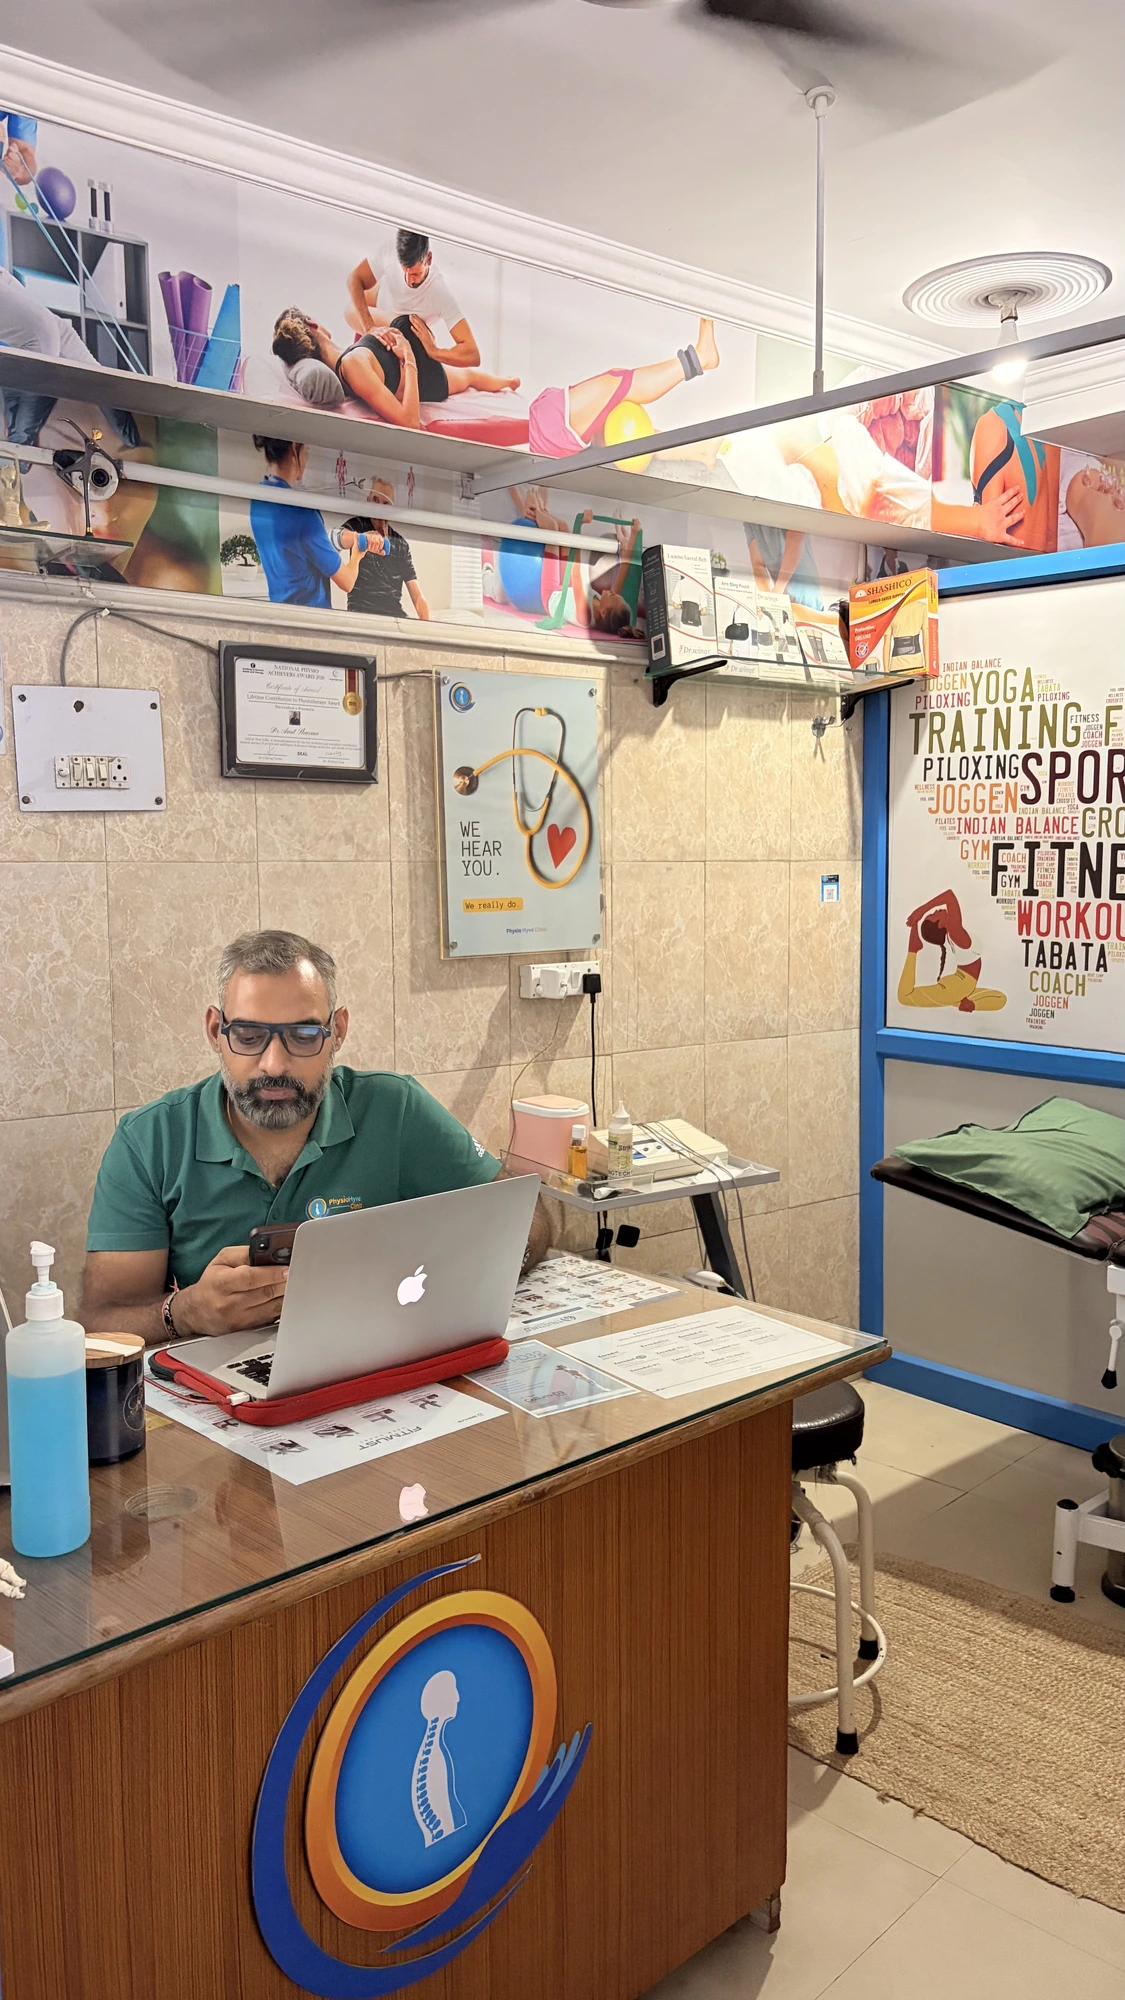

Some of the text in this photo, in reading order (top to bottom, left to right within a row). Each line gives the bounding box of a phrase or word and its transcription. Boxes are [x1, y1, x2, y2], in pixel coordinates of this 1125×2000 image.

[866, 578, 912, 596] SHASHICO
[943, 658, 1001, 672] INDIAN BALANCE
[921, 672, 967, 692] JOGGEN
[970, 667, 1034, 706] YOGA
[1037, 683, 1060, 693] TABATA
[915, 692, 970, 710] PILOXING
[1037, 691, 1070, 702] PILOXING
[1070, 714, 1099, 723] FITNESS
[909, 702, 1081, 755] TRAINING
[1083, 731, 1103, 739] COACH
[1081, 740, 1103, 748] JOGGEN
[923, 754, 1018, 782] PILOXING
[1020, 749, 1125, 805] SPOR
[928, 782, 1018, 814] JOGGEN
[1018, 807, 1066, 815] INDIAN BALANCE
[460, 821, 480, 837] WE
[956, 816, 1079, 834] INDIAN BALANCE
[461, 840, 502, 857] HEAR
[960, 839, 990, 860] GYM
[1001, 852, 1026, 863] COACH
[462, 860, 499, 876] YOU.
[1001, 875, 1020, 888] GYM
[478, 901, 503, 910] really
[507, 900, 519, 908] do.
[1021, 939, 1108, 972] TABATA
[1029, 970, 1086, 996] COACH
[1033, 995, 1069, 1009] JOGGEN
[1029, 1008, 1055, 1019] JOGGEN
